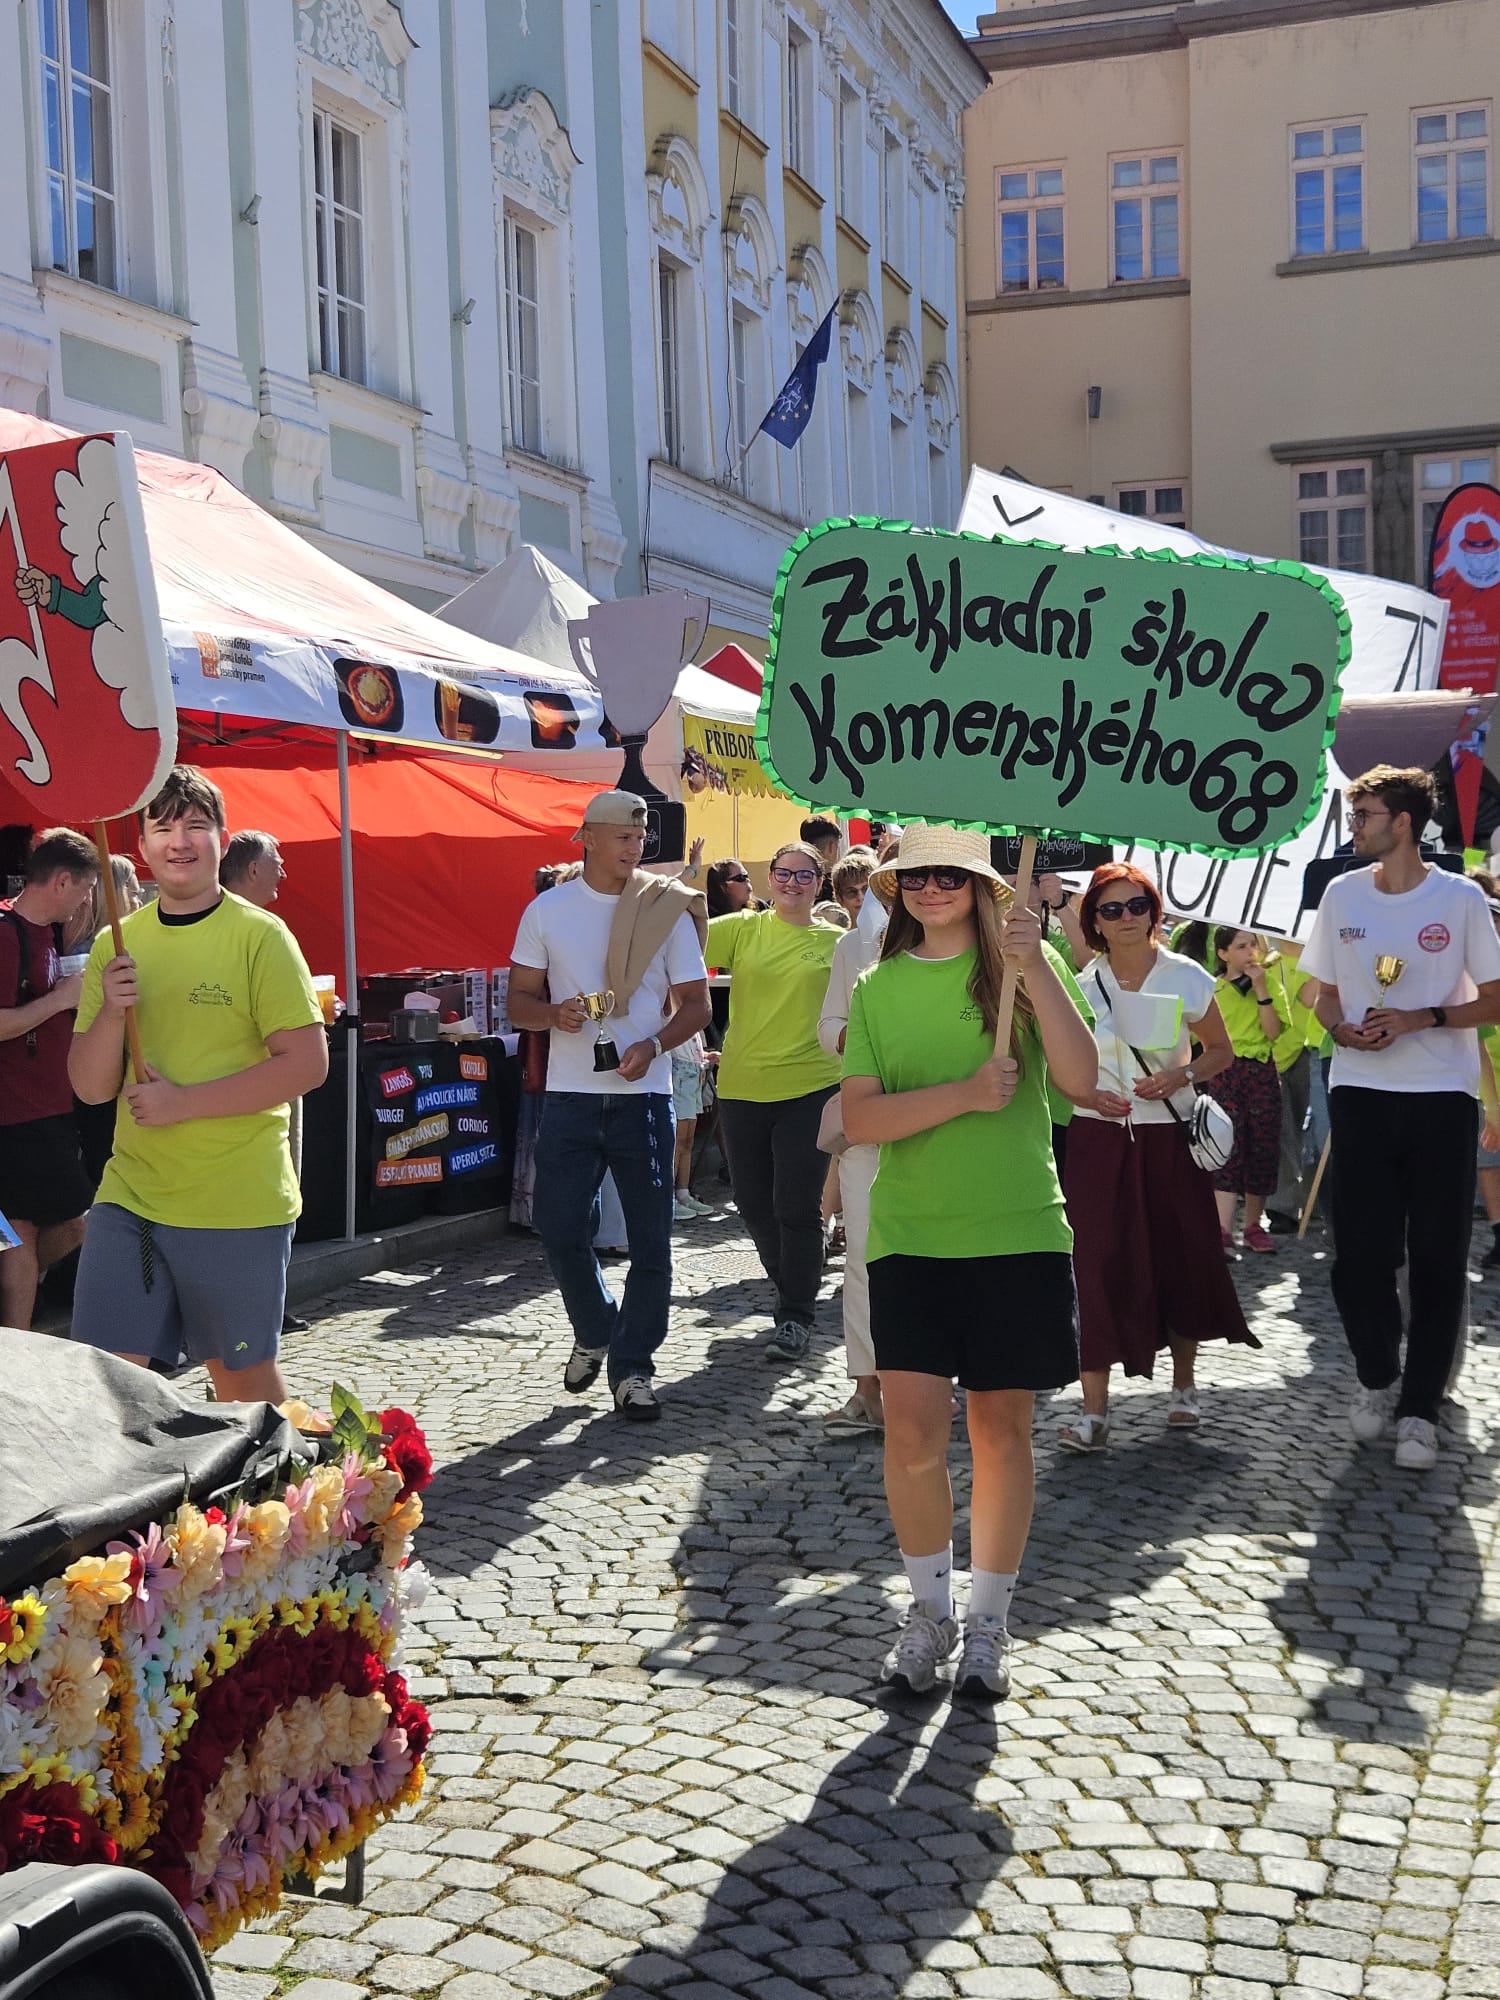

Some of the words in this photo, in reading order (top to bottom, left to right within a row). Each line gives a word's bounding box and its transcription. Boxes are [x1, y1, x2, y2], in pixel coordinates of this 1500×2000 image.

[801, 553, 1107, 674] Základní
[1121, 588, 1324, 732] škola
[790, 673, 1196, 808] Komenského
[1190, 738, 1299, 845] 68
